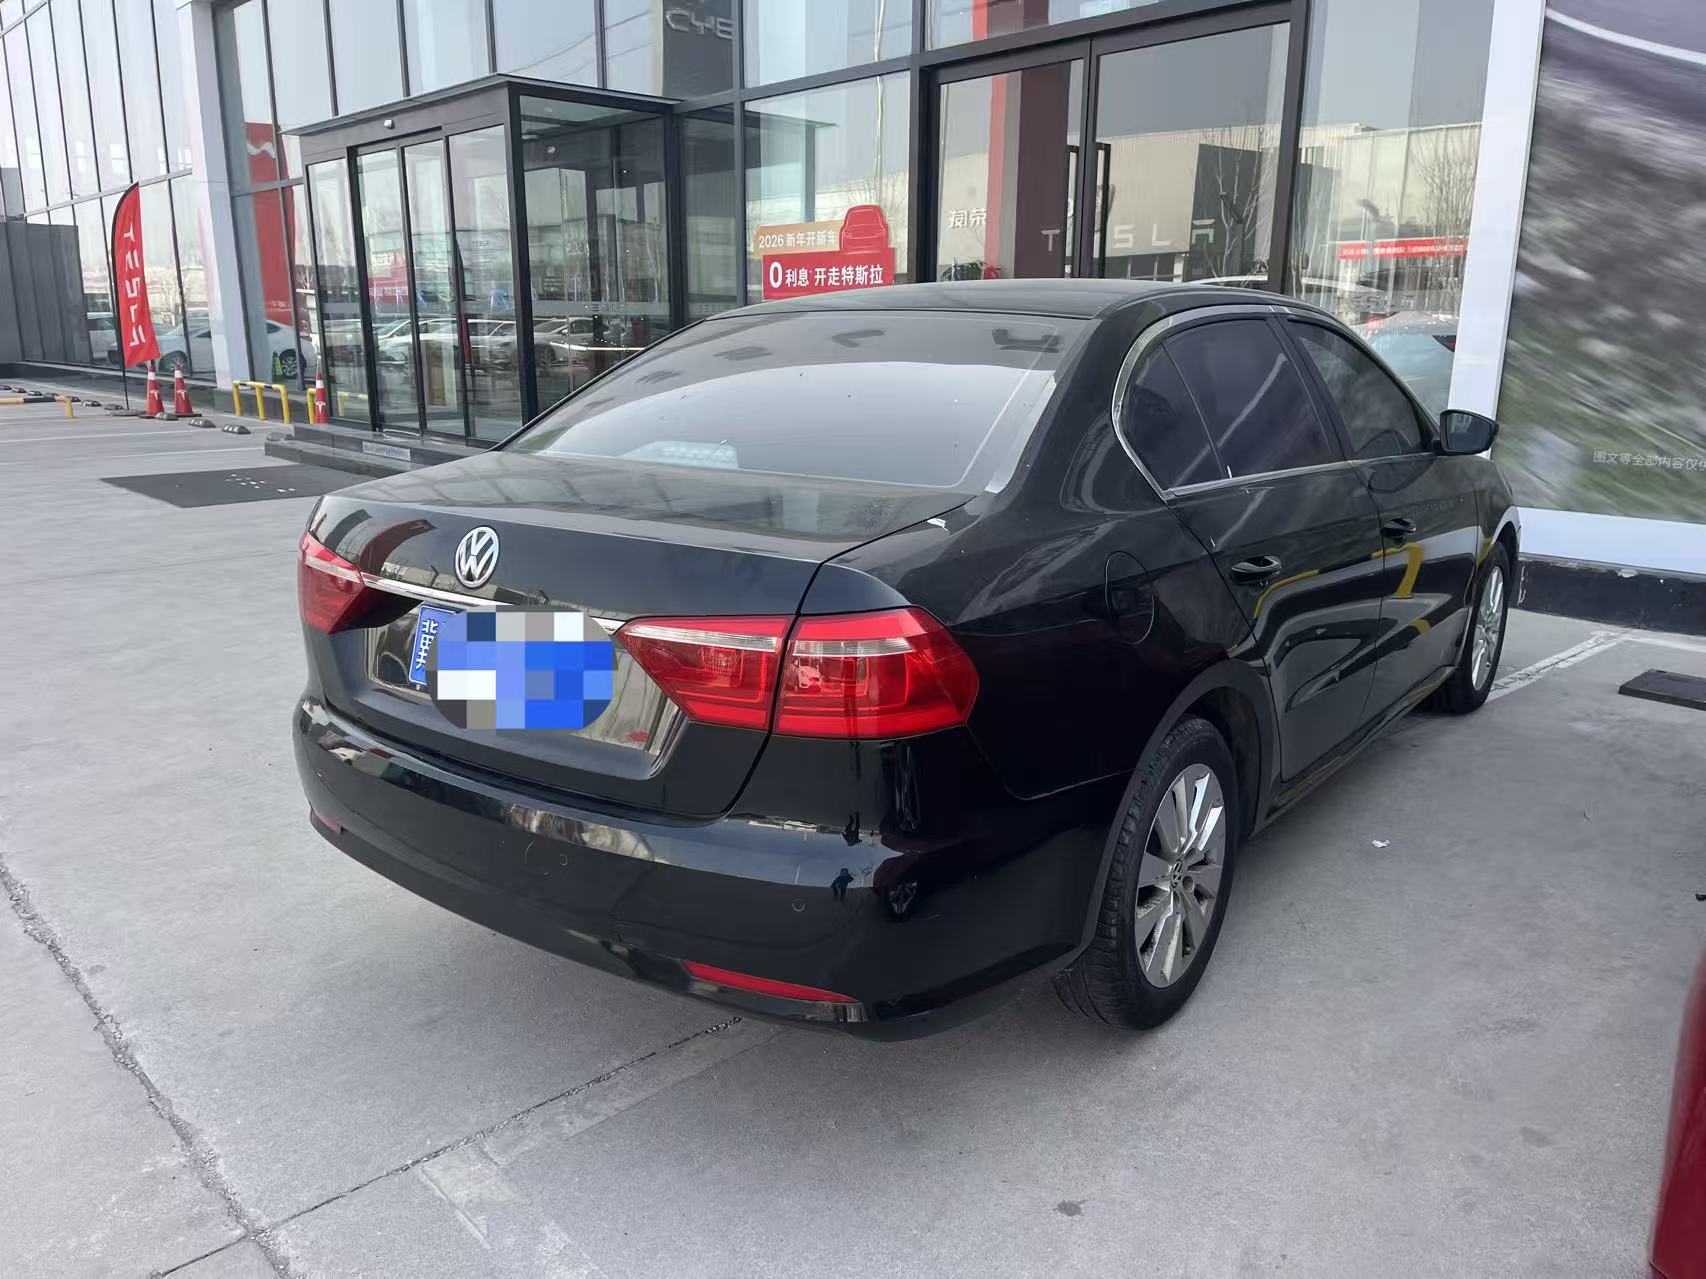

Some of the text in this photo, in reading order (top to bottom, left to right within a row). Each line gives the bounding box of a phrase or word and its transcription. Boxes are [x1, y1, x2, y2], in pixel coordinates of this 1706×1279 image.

[758, 233, 784, 249] 2026
[1041, 218, 1216, 252] TSLA
[123, 221, 146, 347] TESLA
[814, 263, 884, 287] 开走特斯拉
